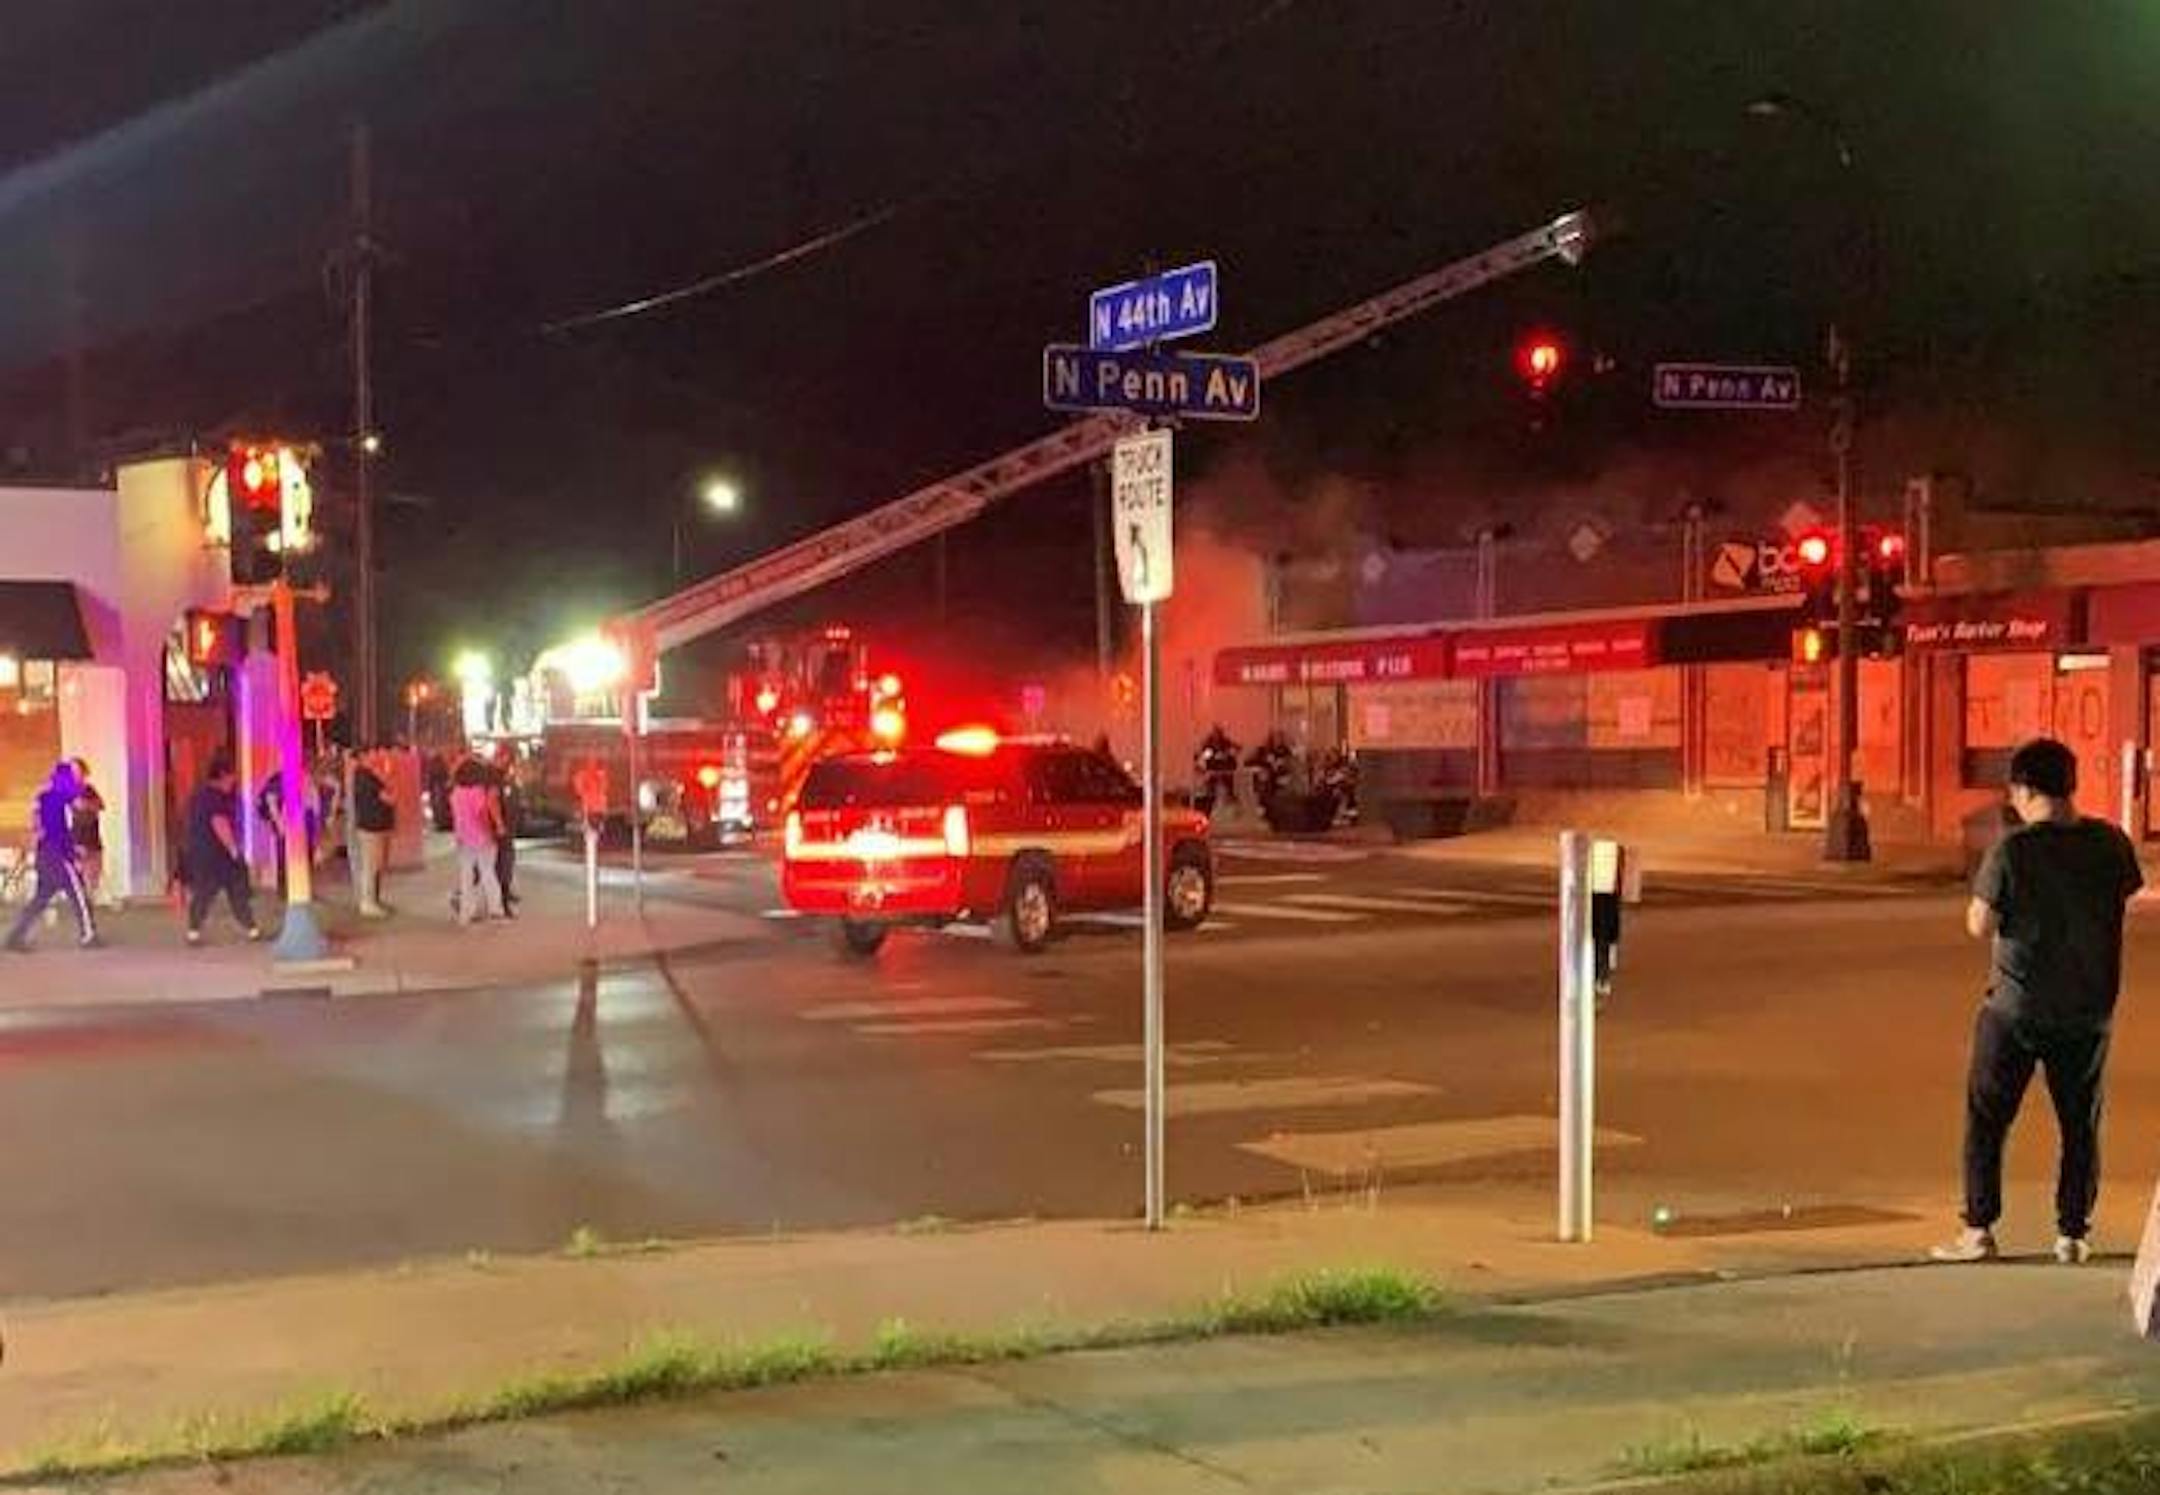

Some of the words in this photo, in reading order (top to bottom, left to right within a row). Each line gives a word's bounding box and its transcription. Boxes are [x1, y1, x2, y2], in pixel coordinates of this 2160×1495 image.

[1096, 302, 1112, 344] N
[1117, 289, 1171, 333] 44th
[1179, 278, 1210, 320] Av
[1054, 357, 1079, 397] N
[1099, 361, 1188, 404] Penn
[1204, 366, 1248, 406] Av
[1663, 371, 1681, 397] N
